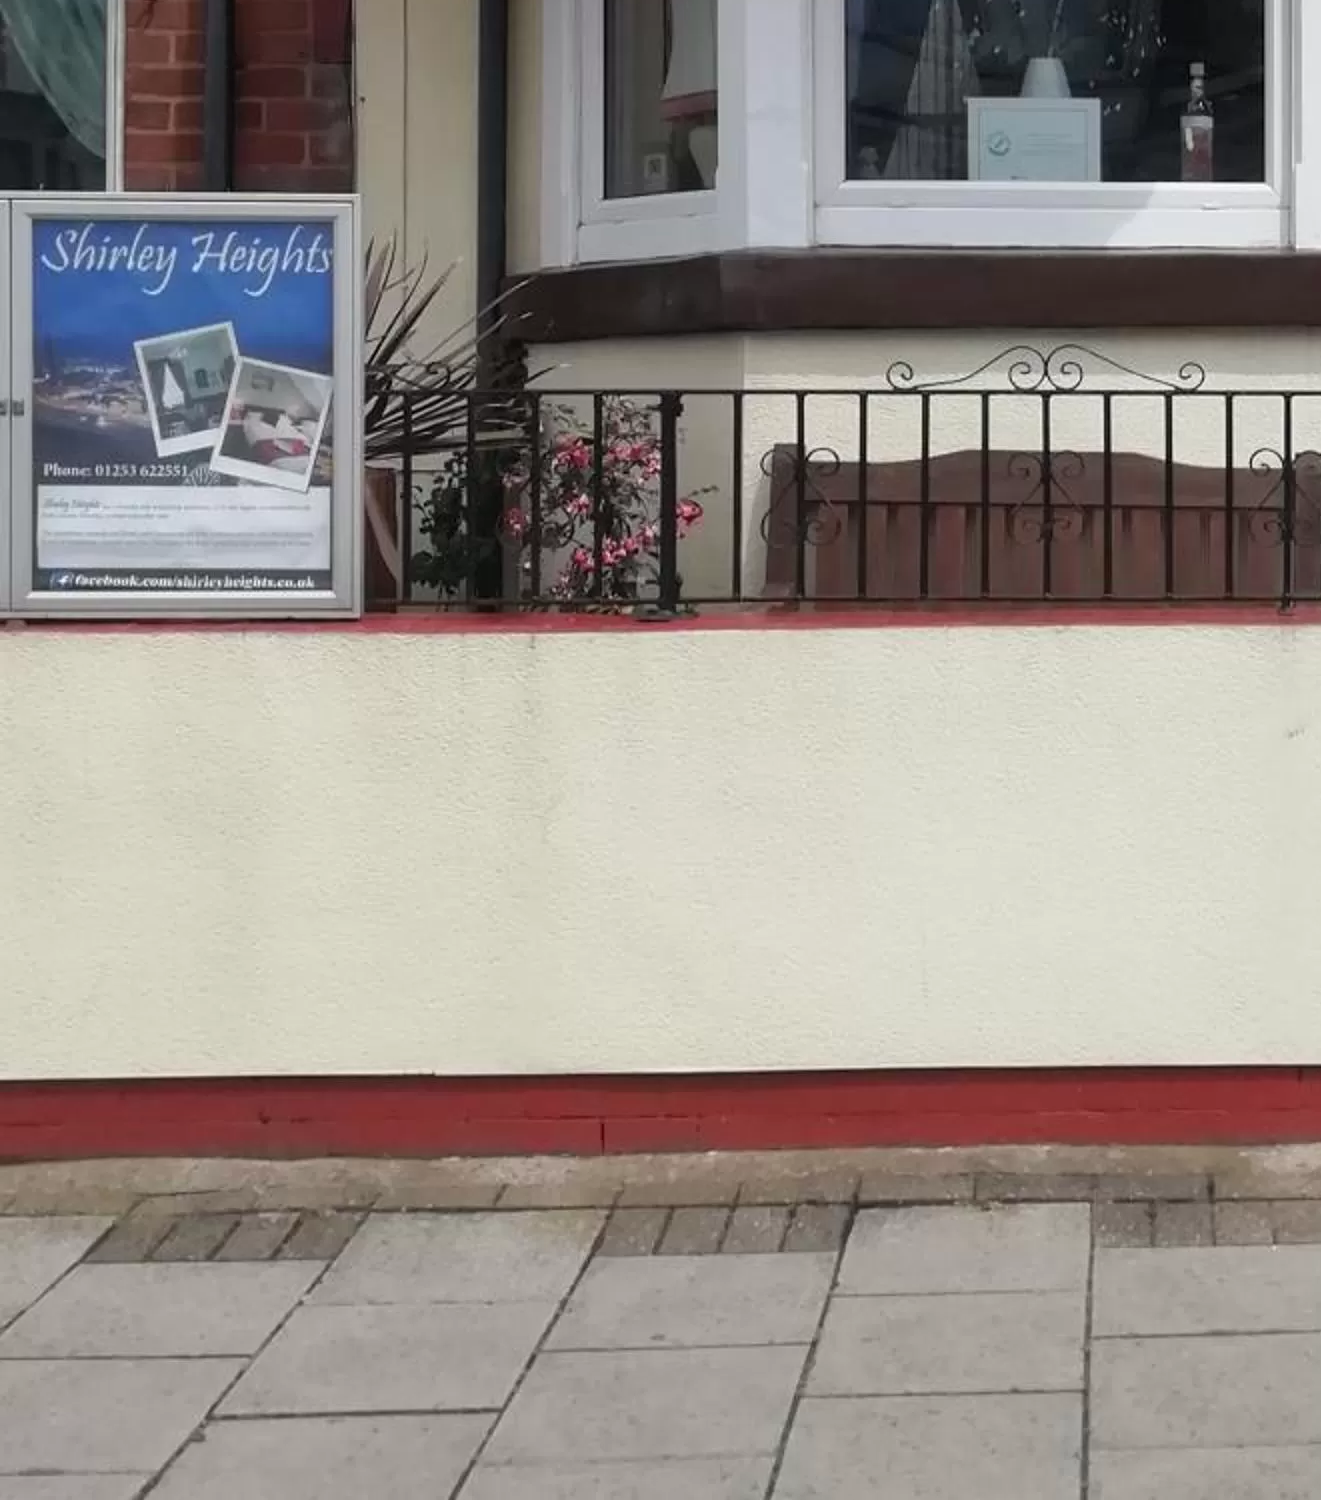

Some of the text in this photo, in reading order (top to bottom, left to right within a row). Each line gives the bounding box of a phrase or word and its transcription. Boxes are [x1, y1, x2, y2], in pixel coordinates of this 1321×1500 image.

[40, 222, 333, 298] Shirley Heights
[43, 462, 188, 478] Phone: 01253 622551
[75, 573, 315, 590] facebook.com/shirleyheights.co.uk
